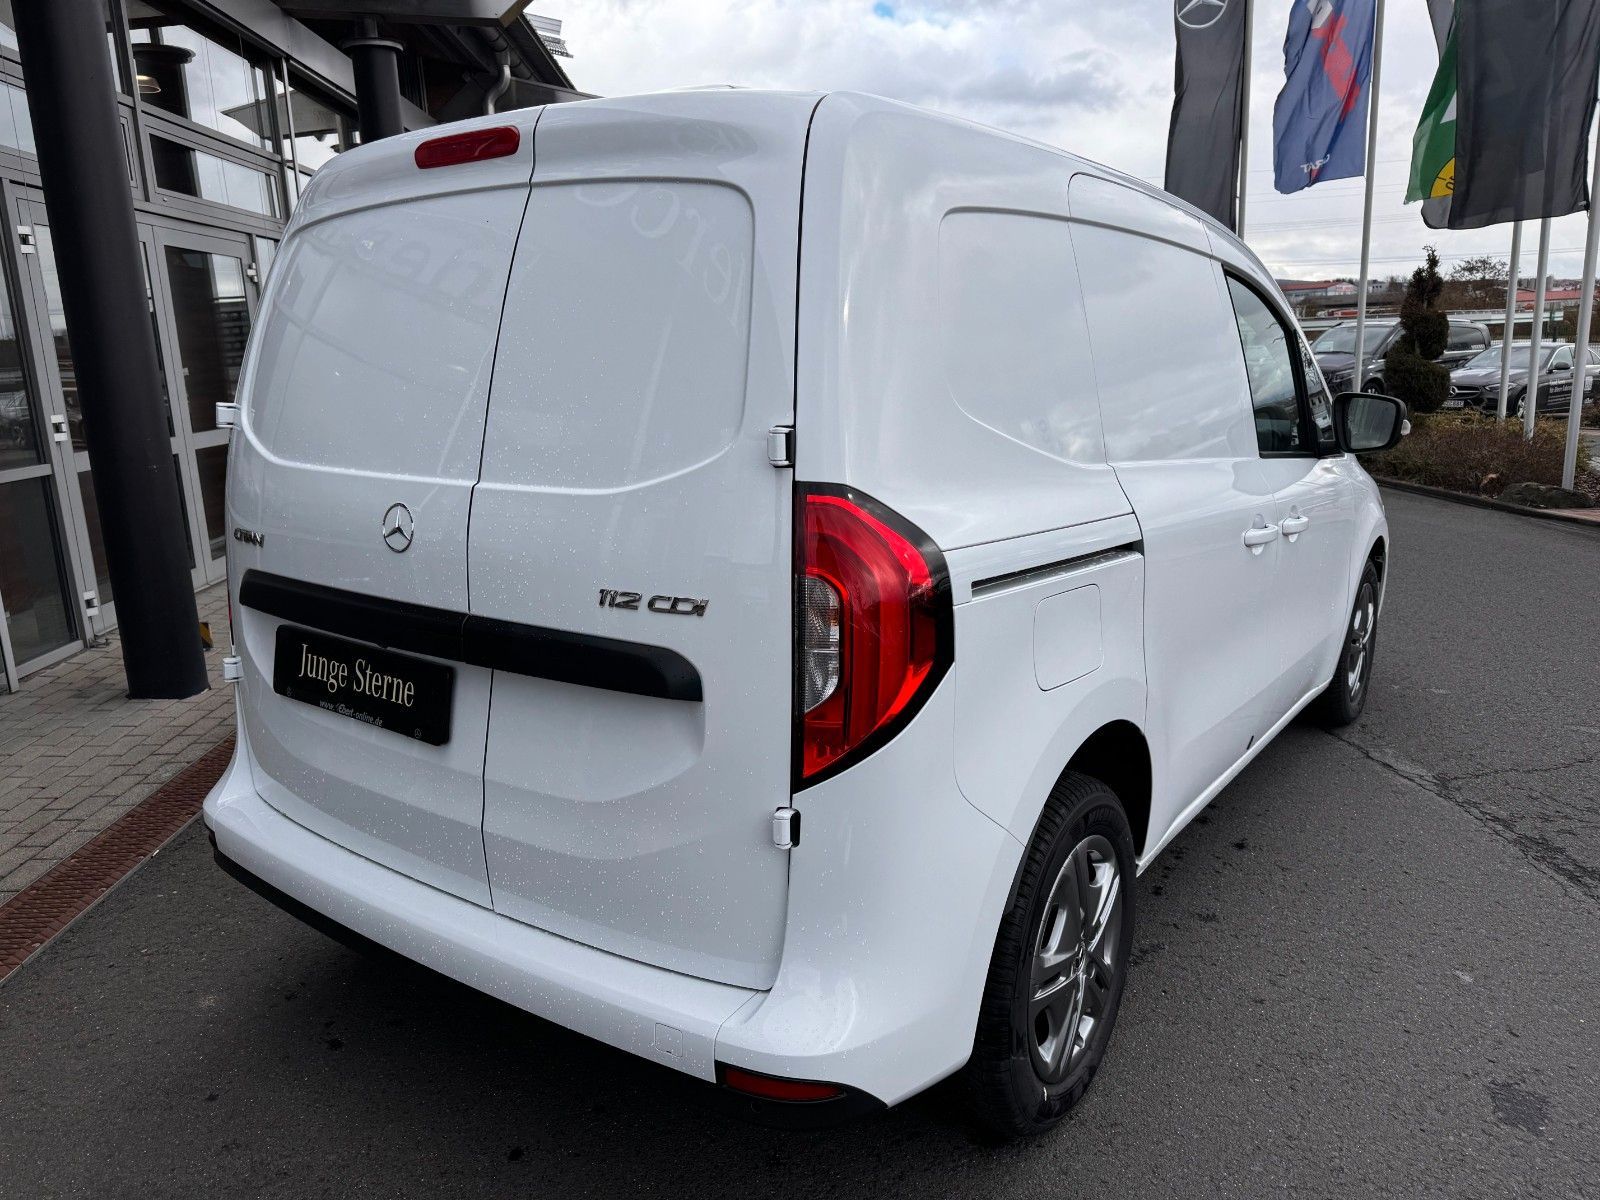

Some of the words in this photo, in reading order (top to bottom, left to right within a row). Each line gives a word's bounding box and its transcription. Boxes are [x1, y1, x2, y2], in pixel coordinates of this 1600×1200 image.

[599, 588, 642, 610] 112
[299, 643, 348, 693] Junge
[353, 658, 415, 707] Sterne
